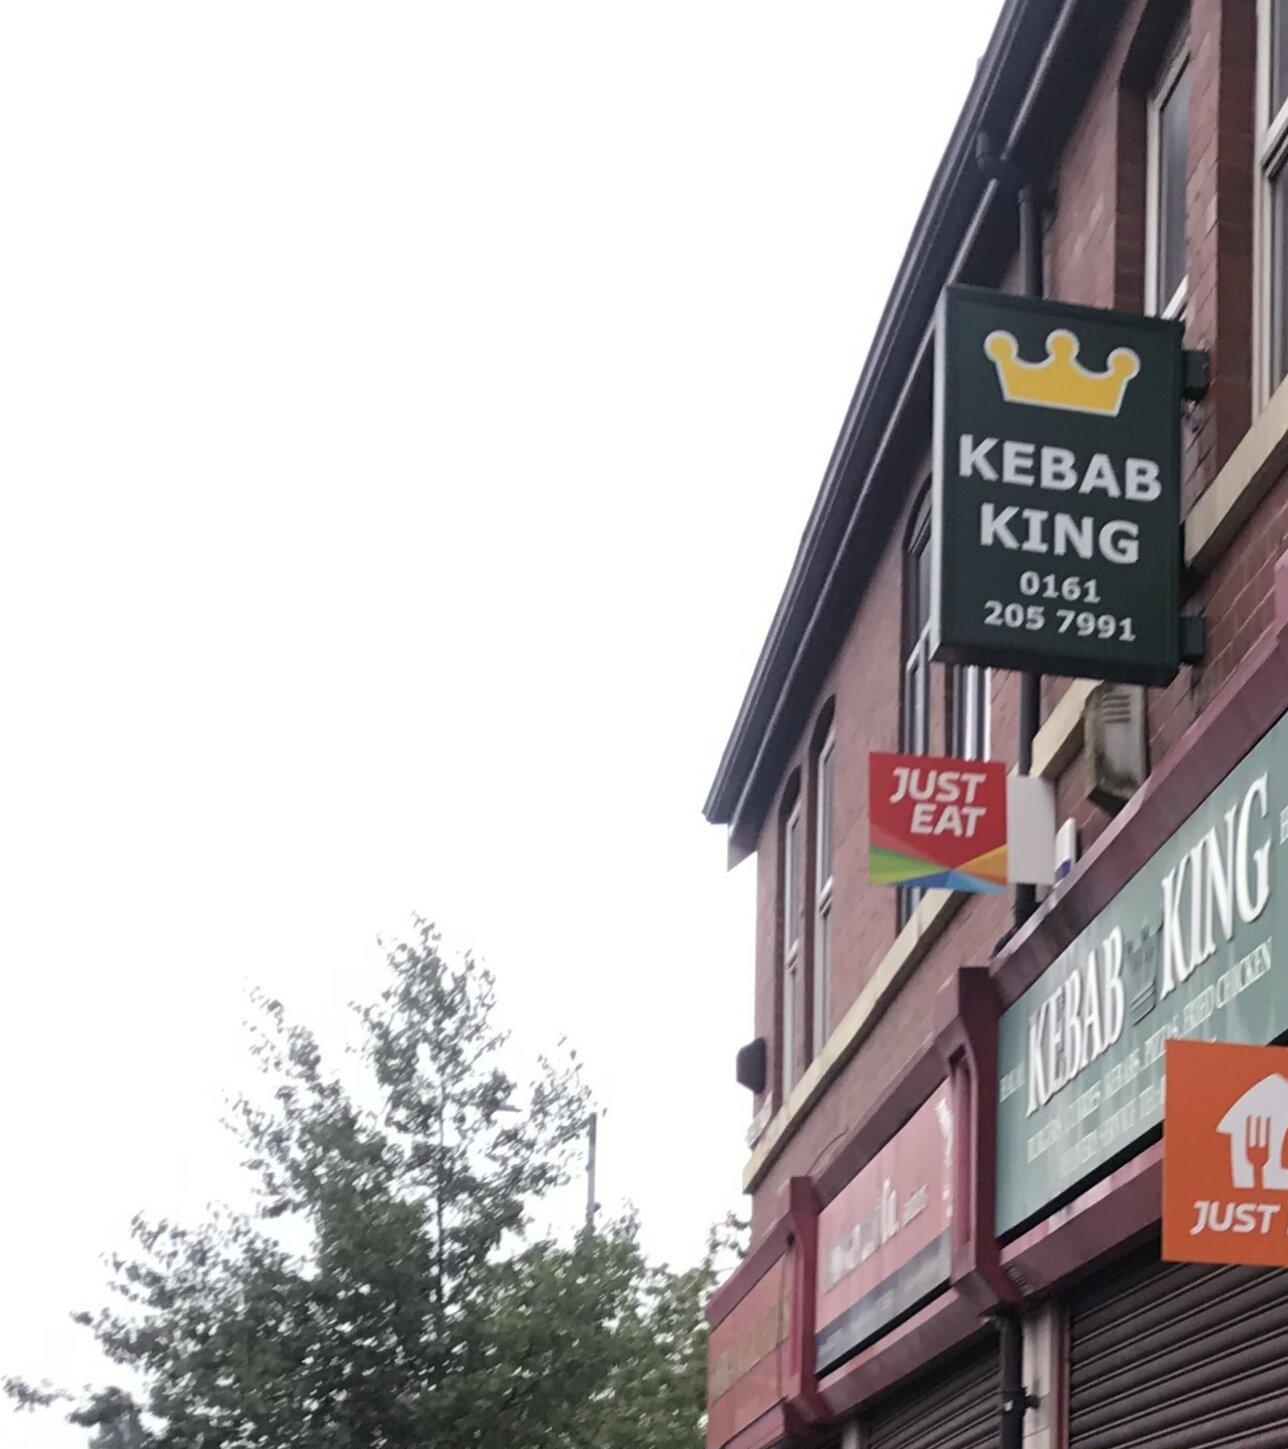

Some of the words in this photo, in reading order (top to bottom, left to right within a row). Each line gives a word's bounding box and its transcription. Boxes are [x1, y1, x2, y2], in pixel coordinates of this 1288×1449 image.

[958, 433, 1163, 503] KEBAB
[979, 501, 1140, 565] KING
[1019, 570, 1102, 604] 0161
[983, 599, 1046, 631] 205
[1056, 608, 1137, 643] 7991
[889, 766, 988, 805] JUST
[909, 802, 988, 838] EAT
[1026, 926, 1125, 1118] KEBAB
[1159, 771, 1272, 1000] KING
[1189, 1200, 1282, 1236] JUST
